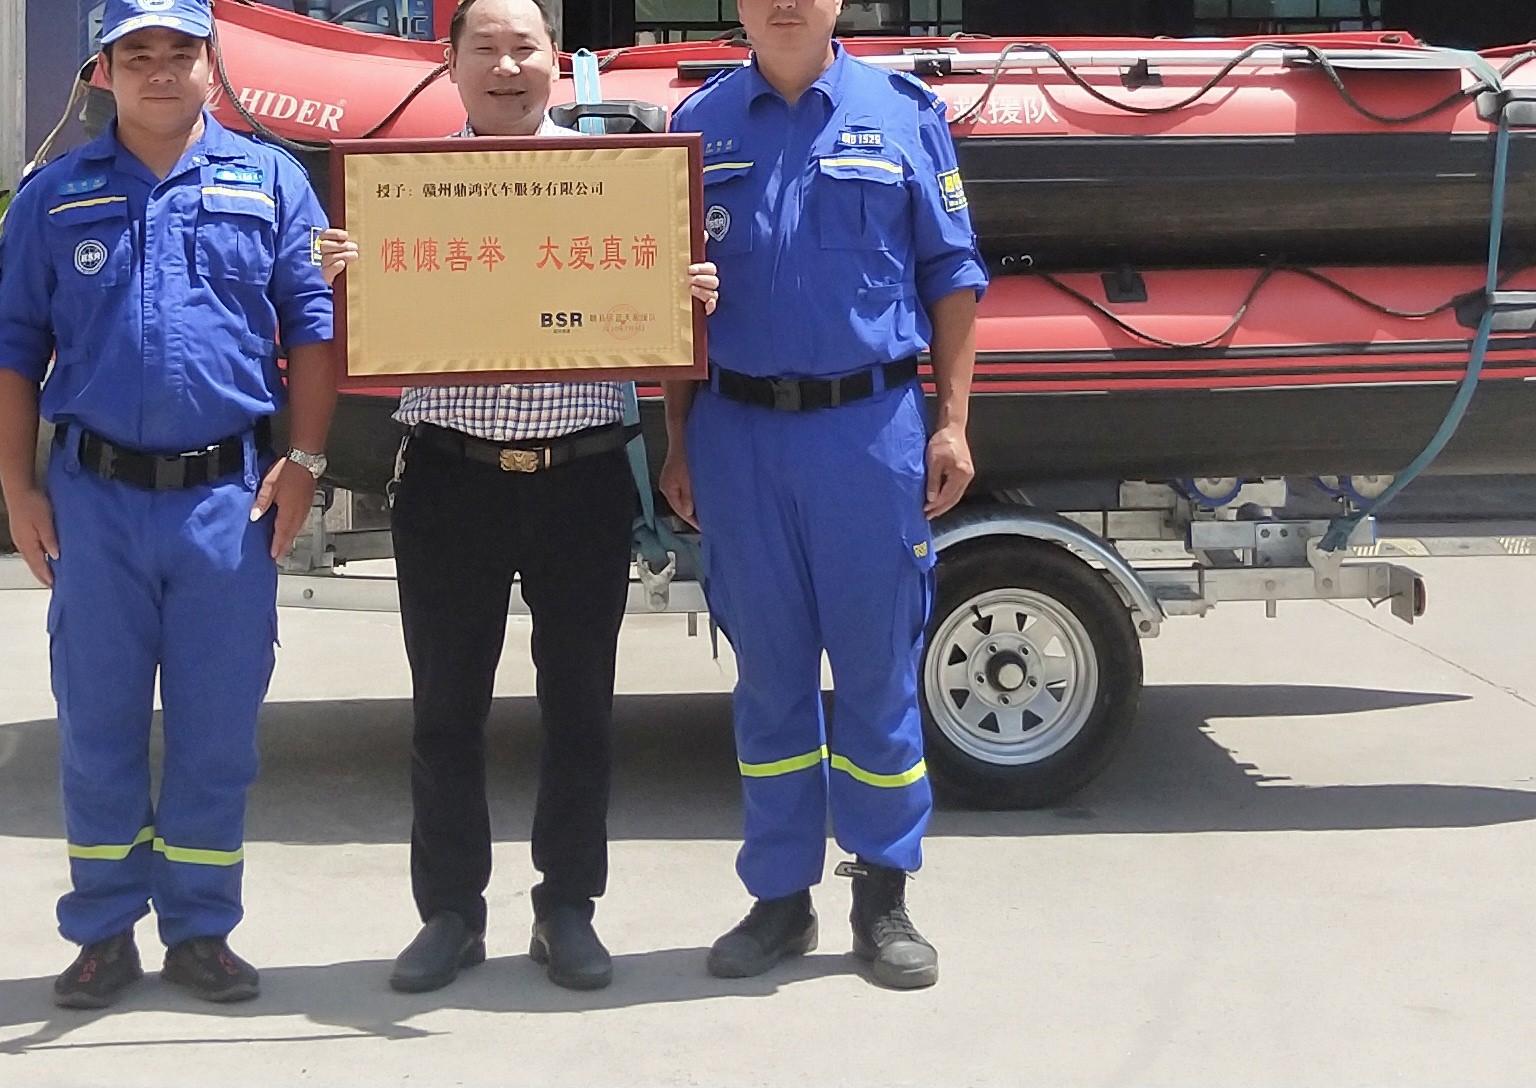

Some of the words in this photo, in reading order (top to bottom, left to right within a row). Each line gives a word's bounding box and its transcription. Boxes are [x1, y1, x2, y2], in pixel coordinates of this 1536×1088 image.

[238, 87, 344, 133] HIDER
[946, 95, 1059, 125] 救援队
[536, 233, 659, 272] 大爱真谛
[540, 312, 583, 328] BSR
